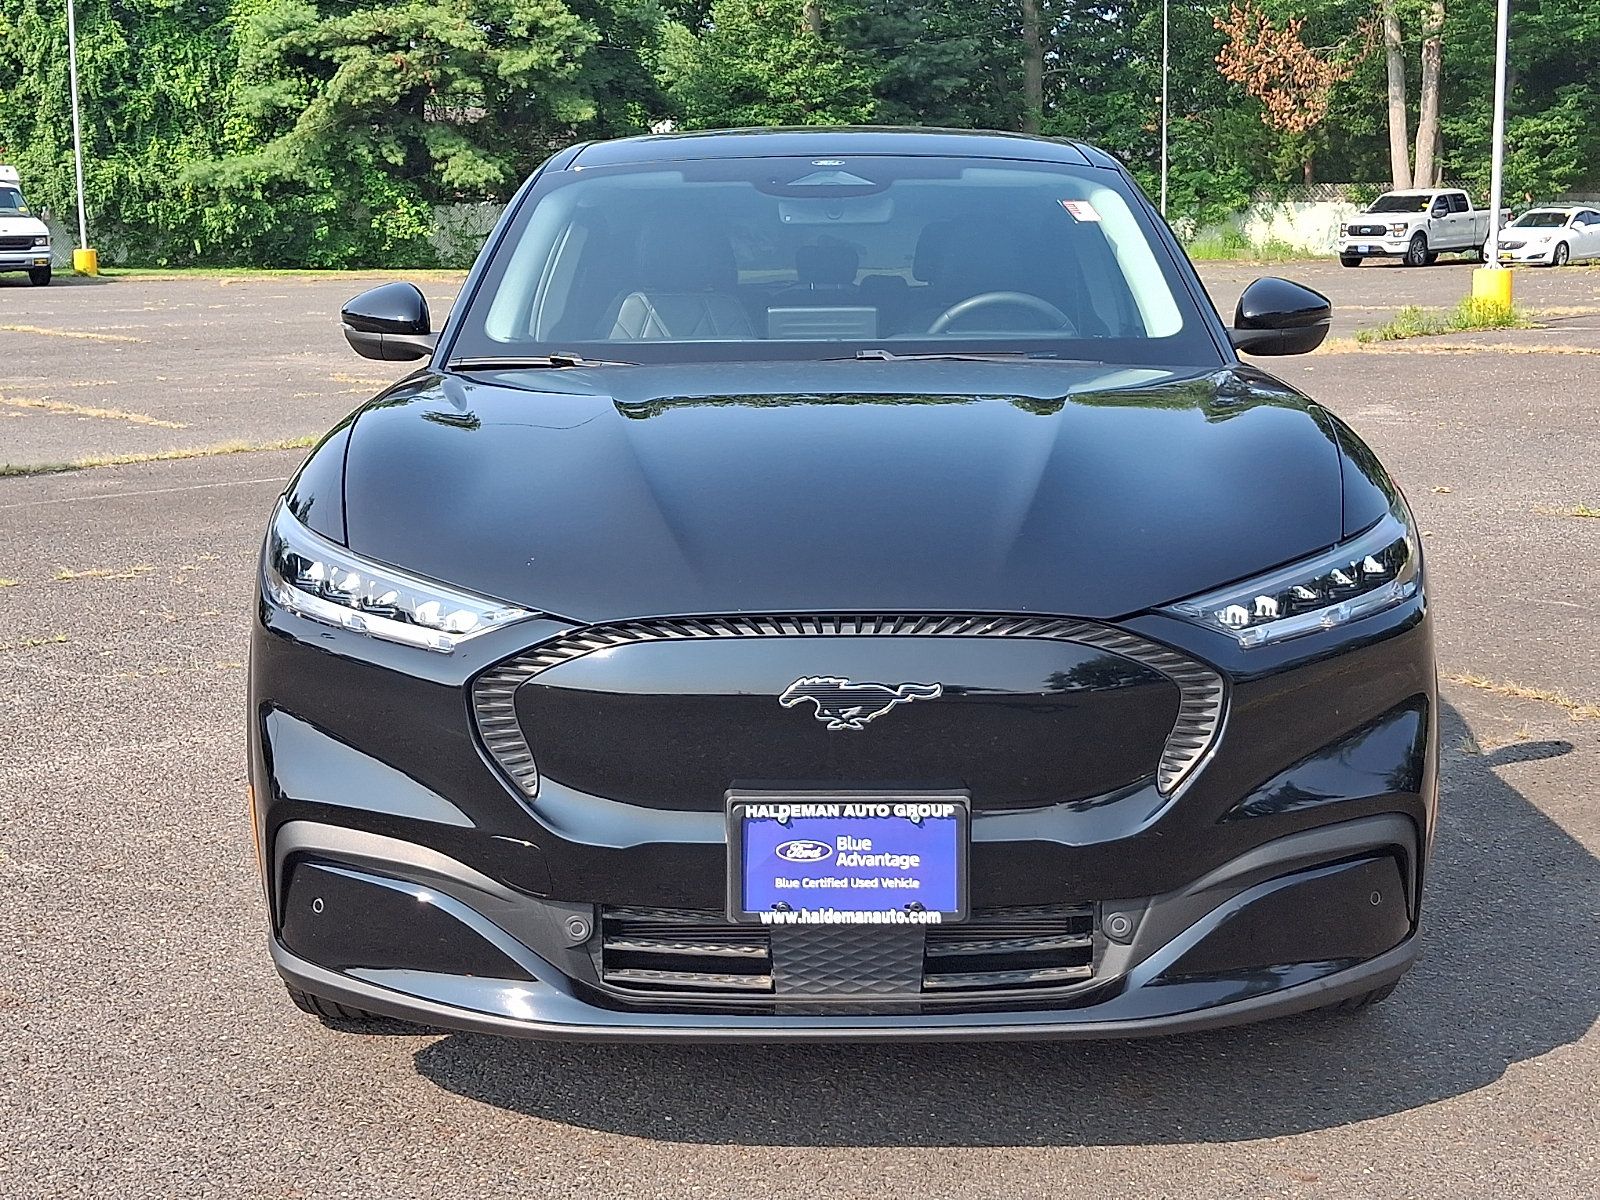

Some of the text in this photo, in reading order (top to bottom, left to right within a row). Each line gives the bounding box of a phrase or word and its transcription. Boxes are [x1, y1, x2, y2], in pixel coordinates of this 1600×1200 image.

[745, 804, 955, 818] HALDEMAN AUTO GROUP
[786, 842, 822, 859] Ford
[836, 835, 872, 851] Blue
[836, 852, 920, 869] Advantage
[774, 877, 920, 889] Blue Certified Used Vehicle
[759, 907, 942, 925] www.haldemanauto.com
